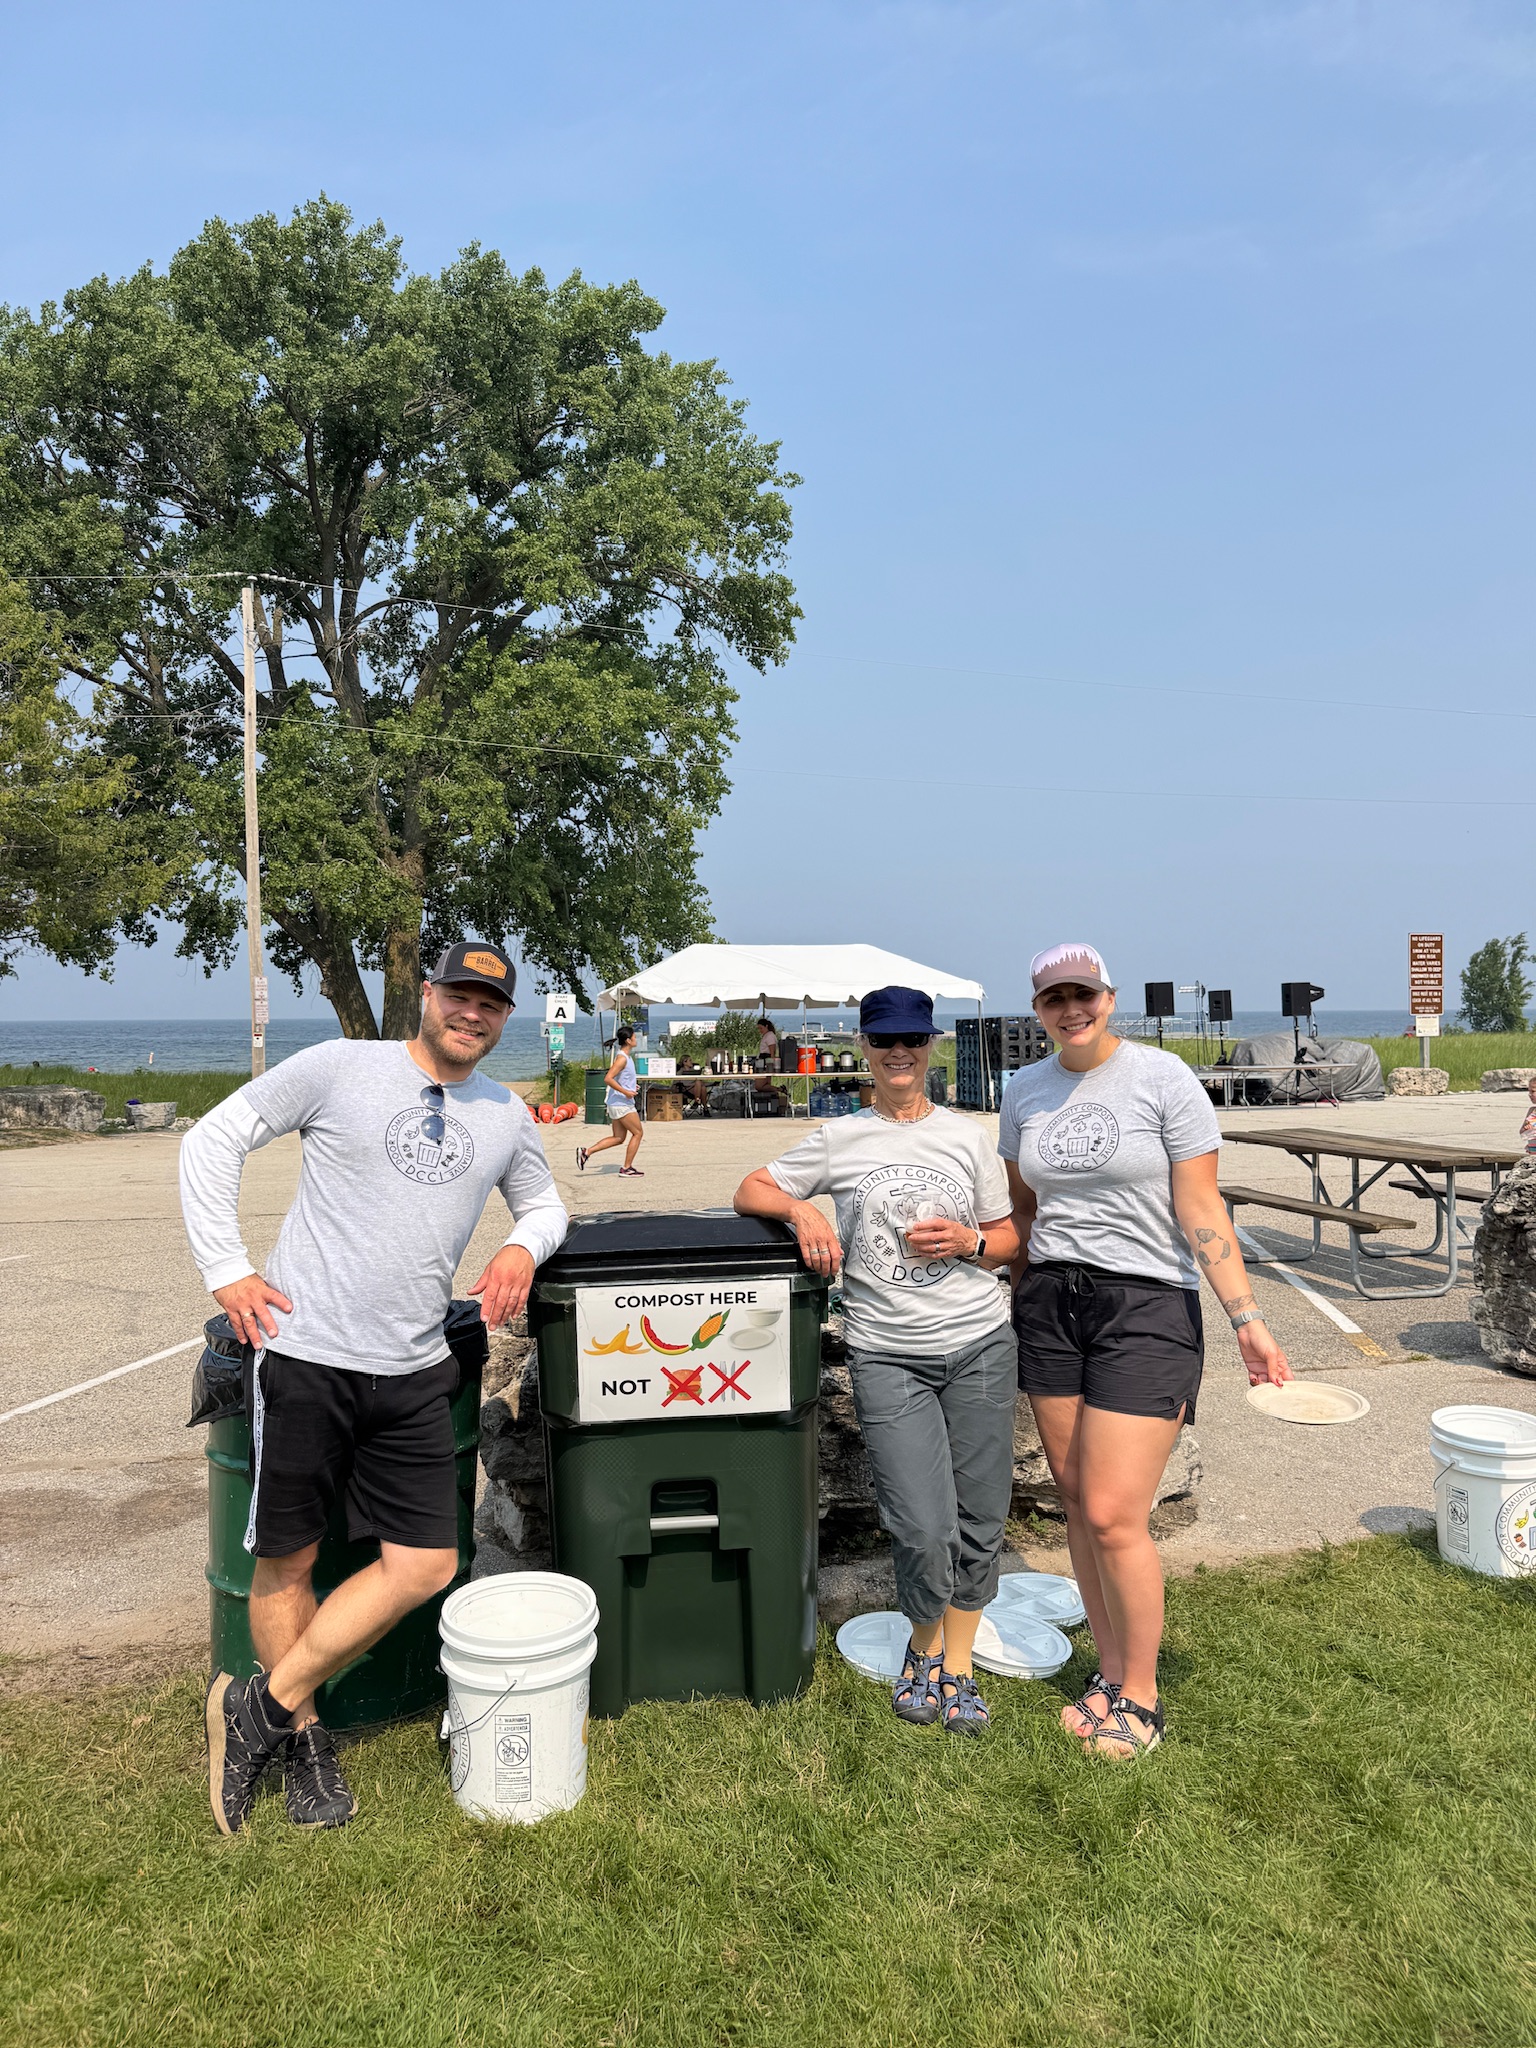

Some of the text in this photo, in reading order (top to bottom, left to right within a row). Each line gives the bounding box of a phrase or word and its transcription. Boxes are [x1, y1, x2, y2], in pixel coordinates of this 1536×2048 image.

[475, 955, 497, 970] BARREL
[554, 1006, 567, 1019] A
[388, 1108, 472, 1178] DOOR COMMUNITY OMPOST INITIATIVE
[1040, 1104, 1117, 1164] DOOR COMMUNITY COMPOST INITIATIVE
[405, 1164, 444, 1183] DCCI
[1060, 1157, 1099, 1171] DCCI
[856, 1236, 883, 1273] DOOR
[905, 1167, 966, 1206] COMPOST
[891, 1258, 949, 1283] DCCI
[614, 1291, 758, 1309] COMPOST HERE
[601, 1379, 652, 1396] NOT
[1499, 1533, 1517, 1559] DOOR
